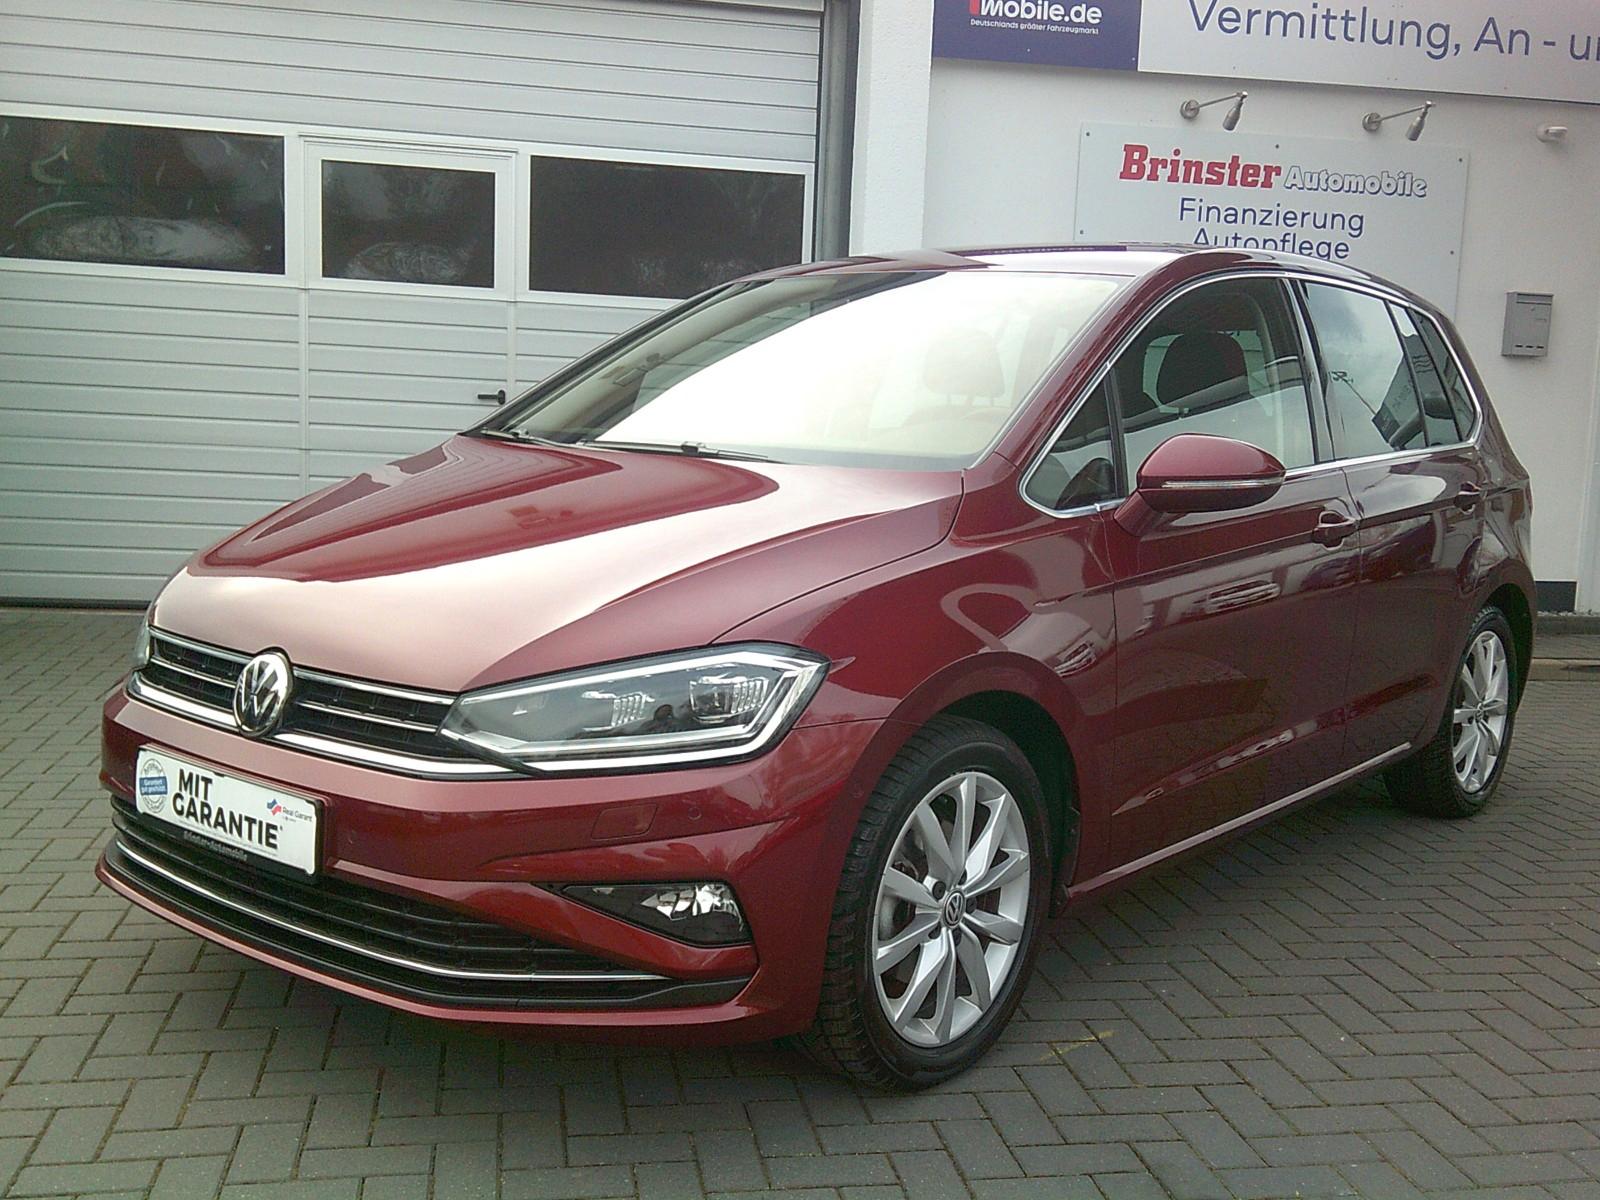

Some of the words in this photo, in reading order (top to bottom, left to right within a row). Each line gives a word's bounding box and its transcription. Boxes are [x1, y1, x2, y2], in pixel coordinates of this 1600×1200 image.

[970, 18, 1019, 29] Deutschlands
[1188, 0, 1461, 60] Vermittlung,
[1473, 16, 1530, 56] An
[1569, 34, 1600, 61] u
[1119, 143, 1282, 189] Brinster
[1284, 165, 1428, 198] Automobile
[1180, 197, 1364, 238] Finanzierung
[178, 768, 213, 802] MIT
[172, 792, 279, 850] GARANTIE
